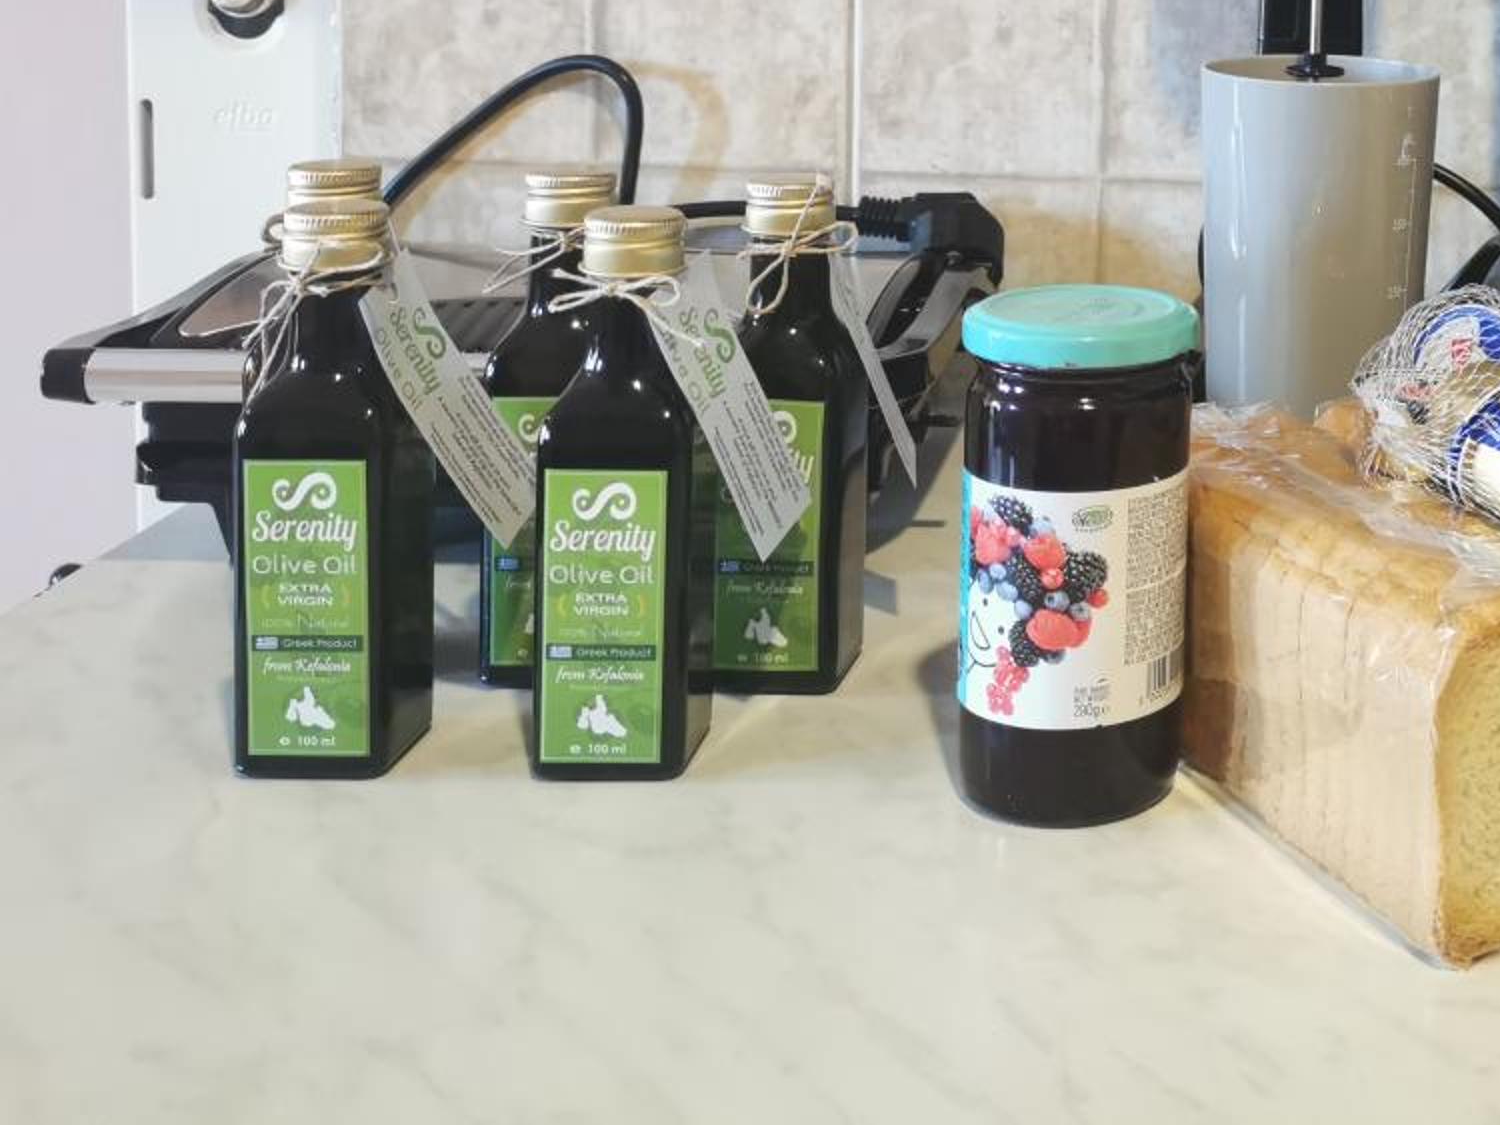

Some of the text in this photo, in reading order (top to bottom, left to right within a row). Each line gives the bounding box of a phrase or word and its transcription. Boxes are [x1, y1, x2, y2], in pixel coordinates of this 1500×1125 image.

[390, 308, 442, 395] Serenity
[374, 326, 423, 413] Olive Oil
[252, 510, 358, 552] Serenity
[550, 519, 656, 562] Serenity
[252, 554, 357, 574] Olive Oil
[549, 564, 654, 584] Olive Oil
[279, 583, 332, 594] EXTRA
[277, 595, 334, 606] VIRGIN
[575, 592, 628, 604] EXTRA
[573, 605, 630, 616] VIRGIN
[297, 736, 318, 747] 100
[321, 736, 337, 747] ml
[588, 743, 609, 754] 100
[611, 743, 627, 754] ml
